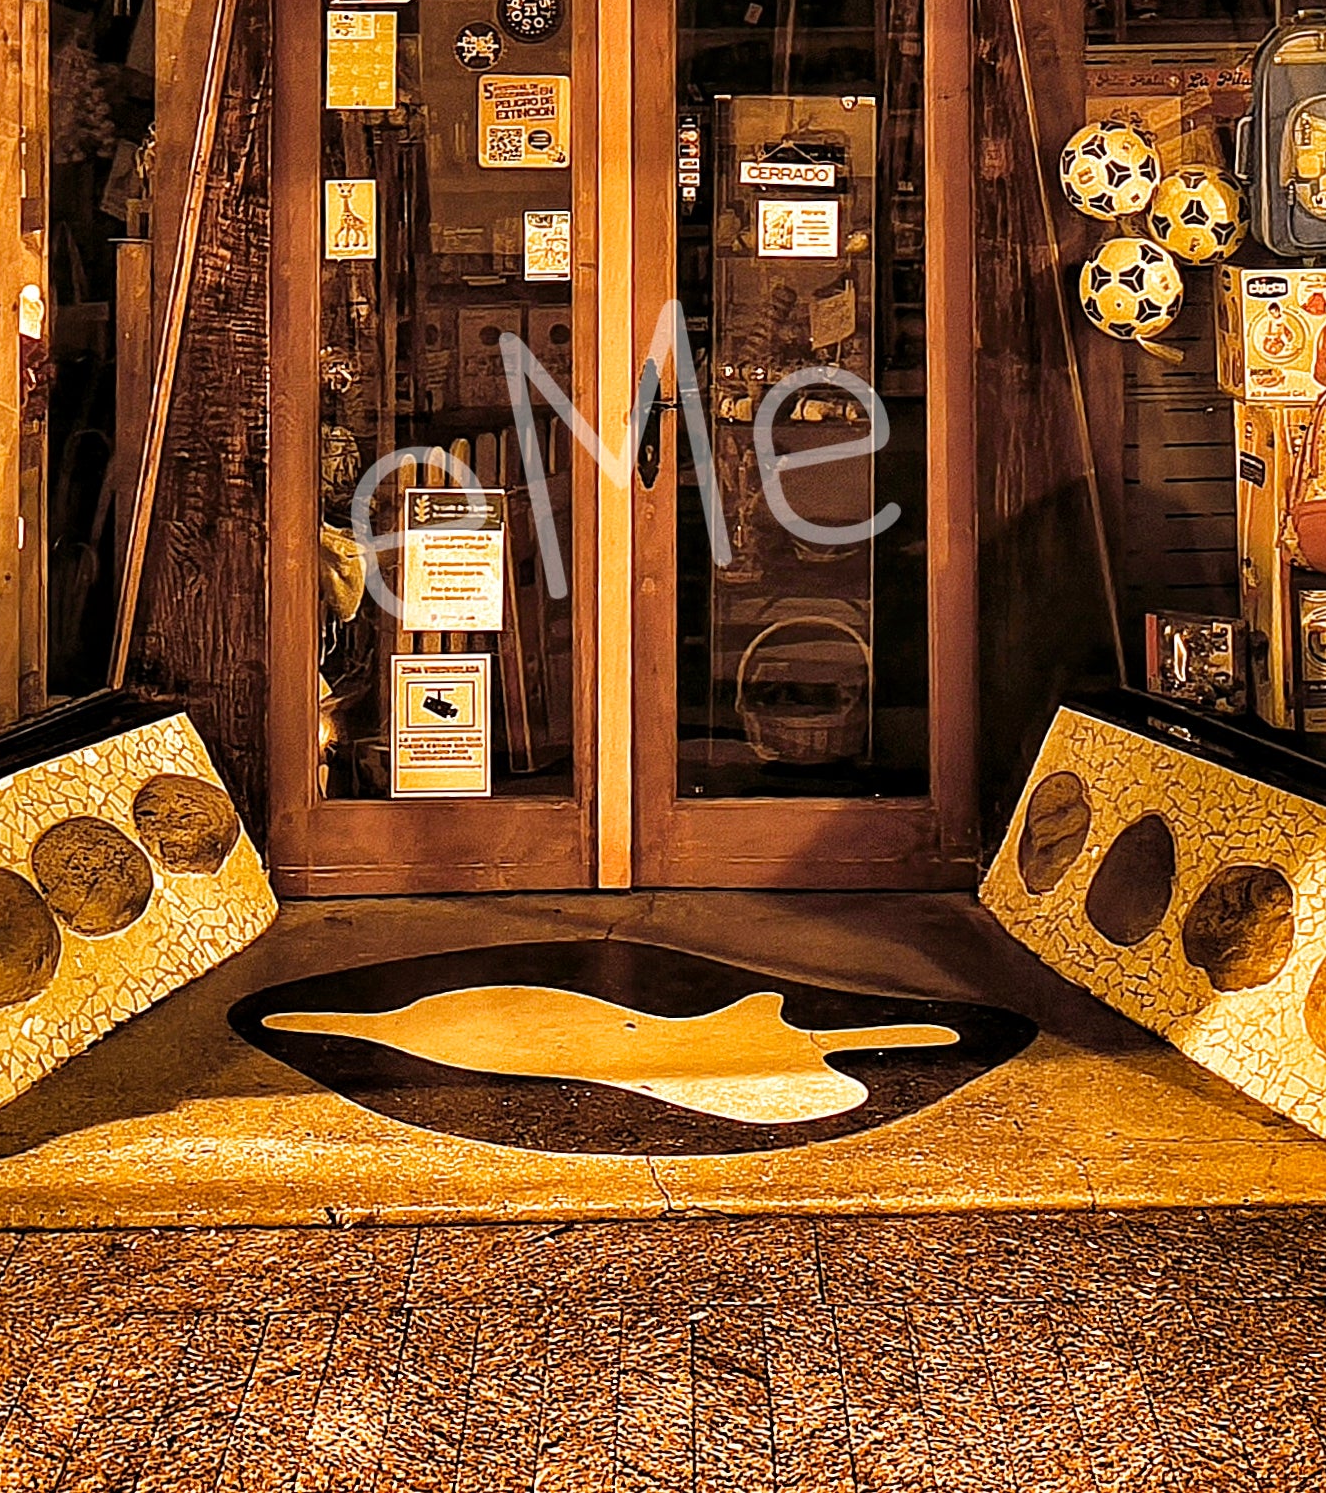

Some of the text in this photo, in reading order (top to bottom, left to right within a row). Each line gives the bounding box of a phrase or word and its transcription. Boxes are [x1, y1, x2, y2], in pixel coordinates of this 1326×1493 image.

[495, 97, 539, 109] PELIGRO
[747, 166, 829, 182] CERRADO
[1249, 279, 1287, 294] chicco
